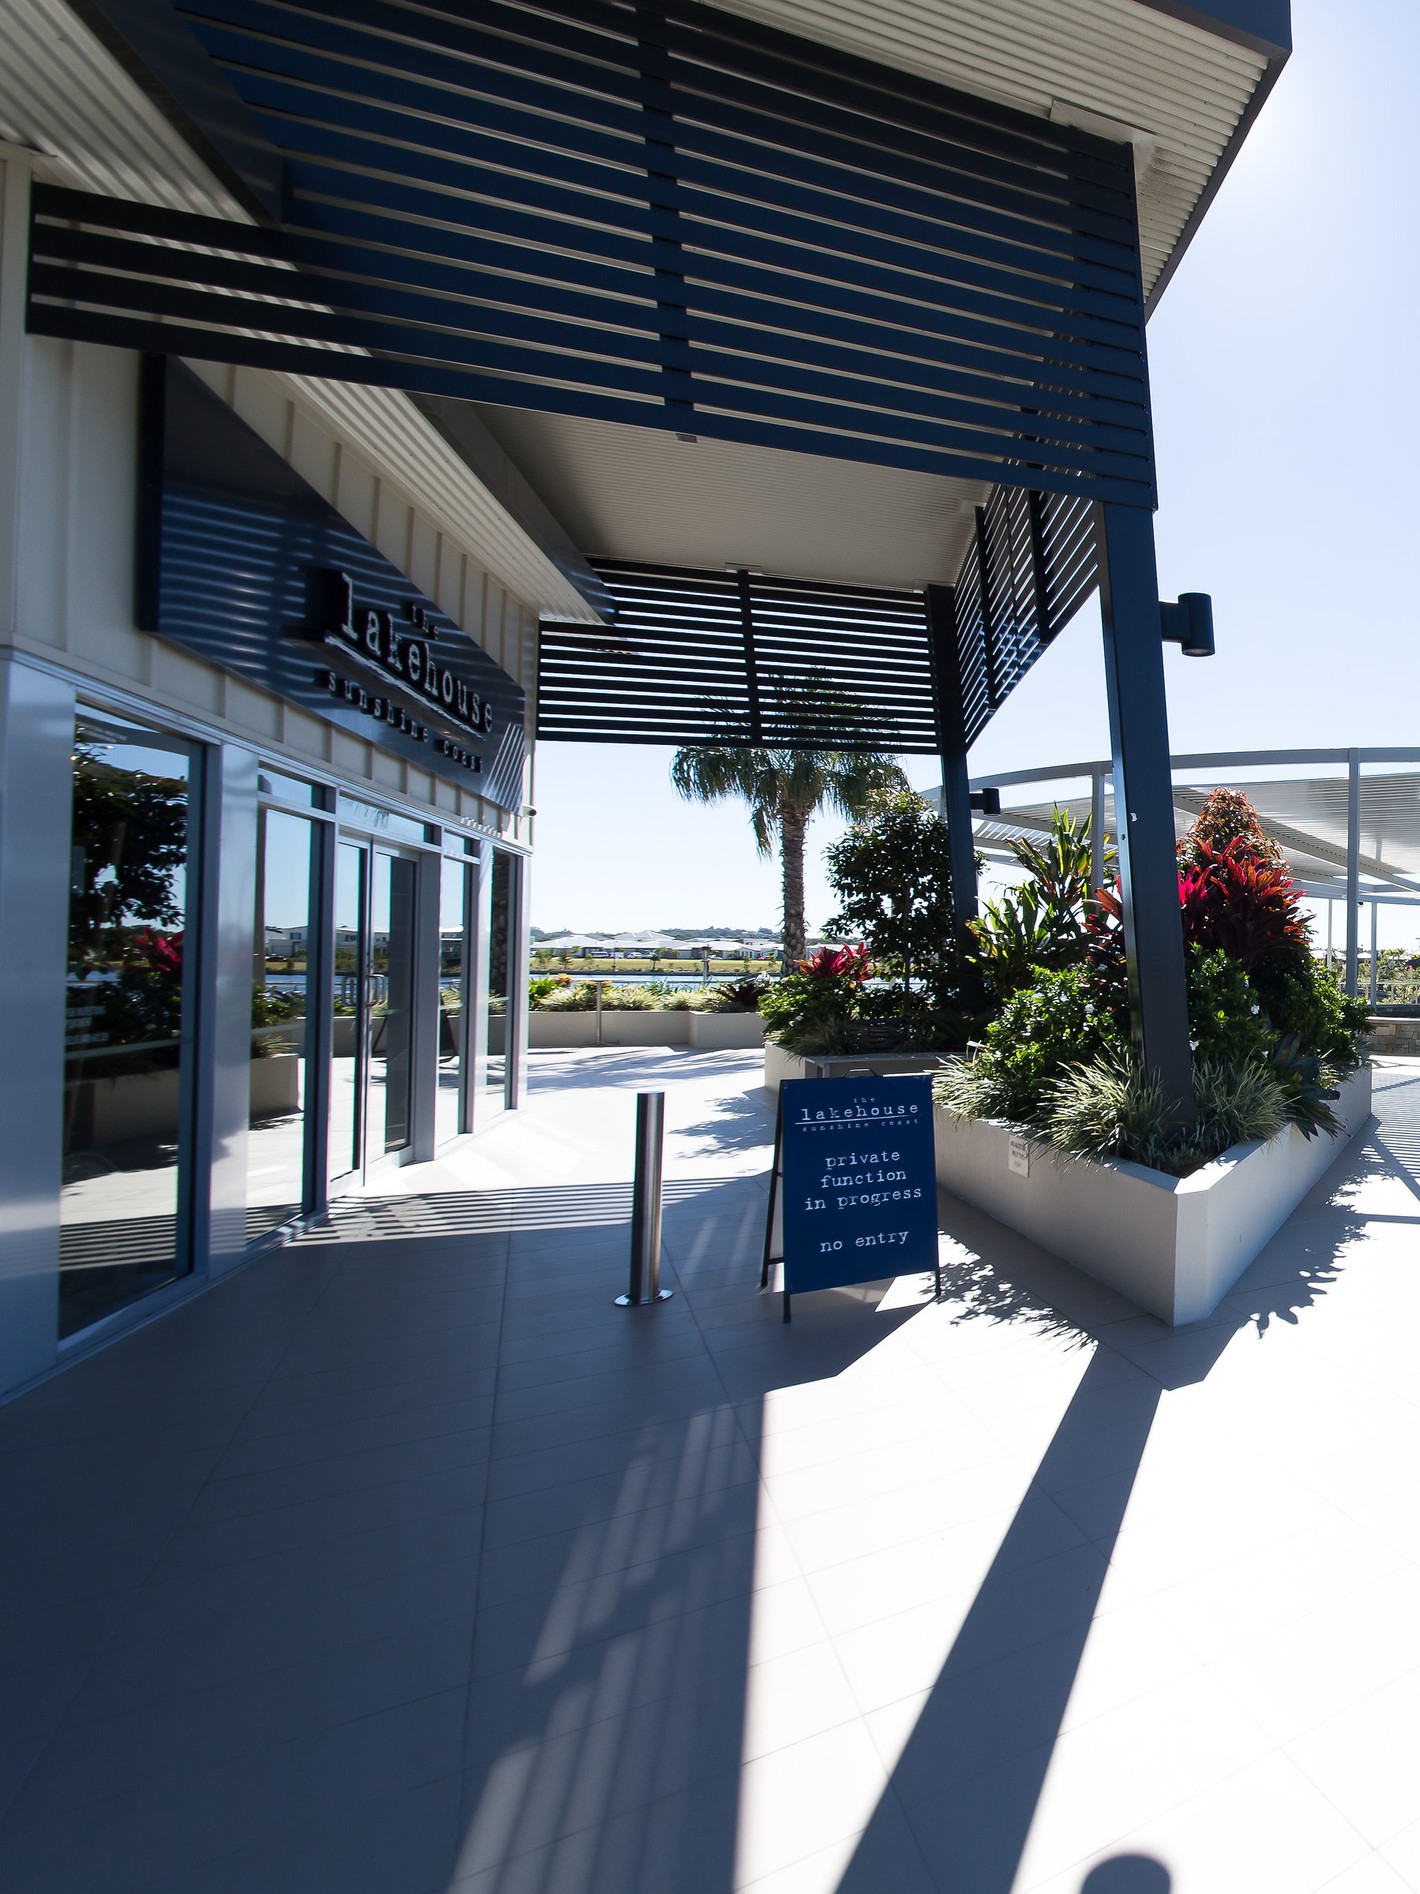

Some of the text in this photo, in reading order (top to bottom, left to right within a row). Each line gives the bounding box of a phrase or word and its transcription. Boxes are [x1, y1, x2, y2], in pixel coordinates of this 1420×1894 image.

[411, 603, 440, 640] the
[340, 571, 494, 733] lakehouse
[328, 671, 484, 774] sunshine coast
[852, 1096, 876, 1104] the
[800, 1104, 919, 1121] lakehouse
[802, 1118, 919, 1132] sunshine coast
[825, 1150, 901, 1171] private
[820, 1169, 908, 1189] function
[803, 1187, 923, 1211] in progress
[819, 1230, 910, 1253] no entry
